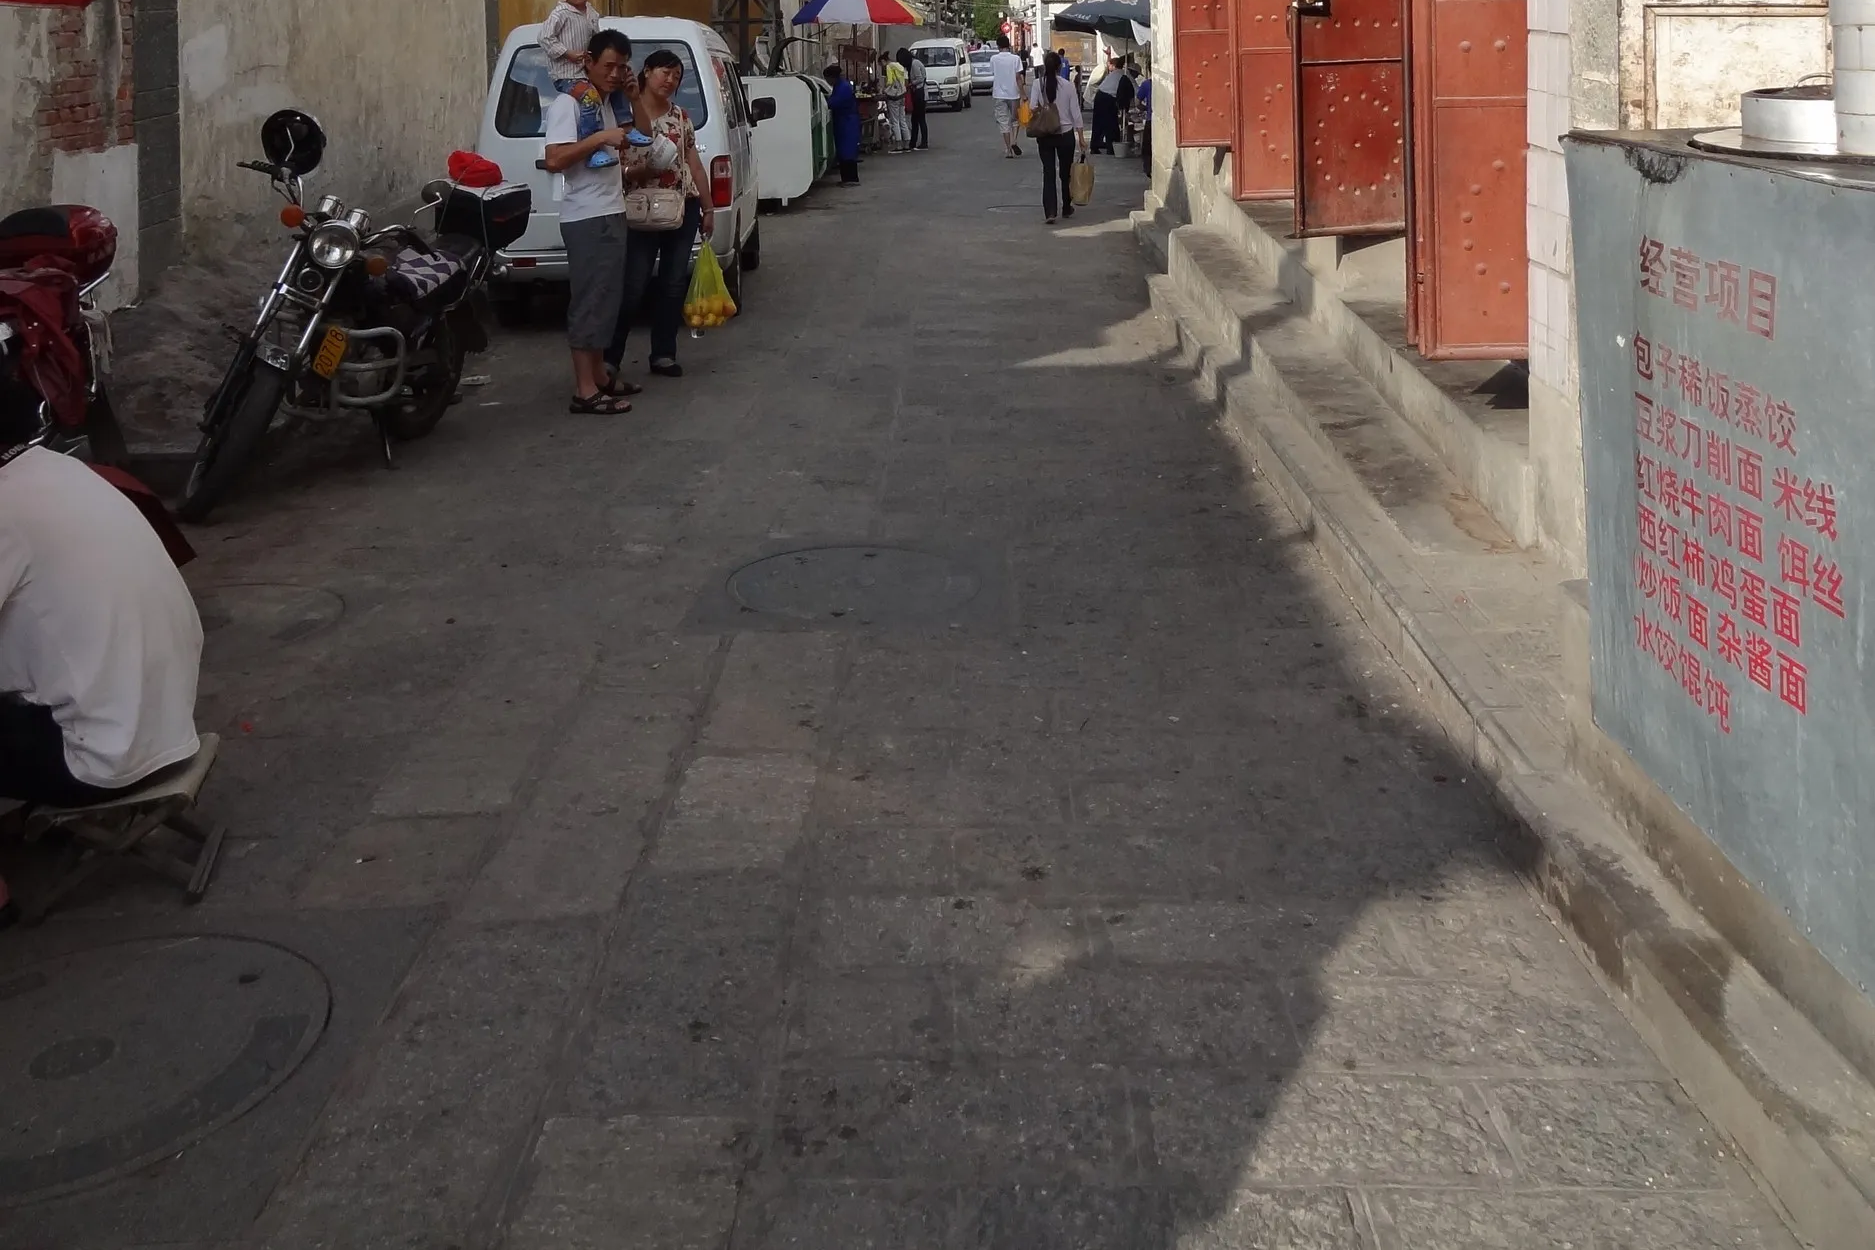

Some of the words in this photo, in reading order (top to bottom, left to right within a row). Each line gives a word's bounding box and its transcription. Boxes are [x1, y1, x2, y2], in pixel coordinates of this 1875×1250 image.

[1640, 235, 1777, 341] 经营项目
[315, 329, 344, 375] 20718
[1634, 329, 1797, 456] 包子稀饭蒸饺
[1634, 391, 1763, 501] 豆浆刀削面
[1772, 466, 1838, 542] 米线
[1635, 447, 1763, 564] 红烧牛肉面
[1777, 532, 1846, 619] 饵丝
[1637, 502, 1800, 648] 西红柿鸡蛋面
[1634, 608, 1731, 734] 水饺馄饨
